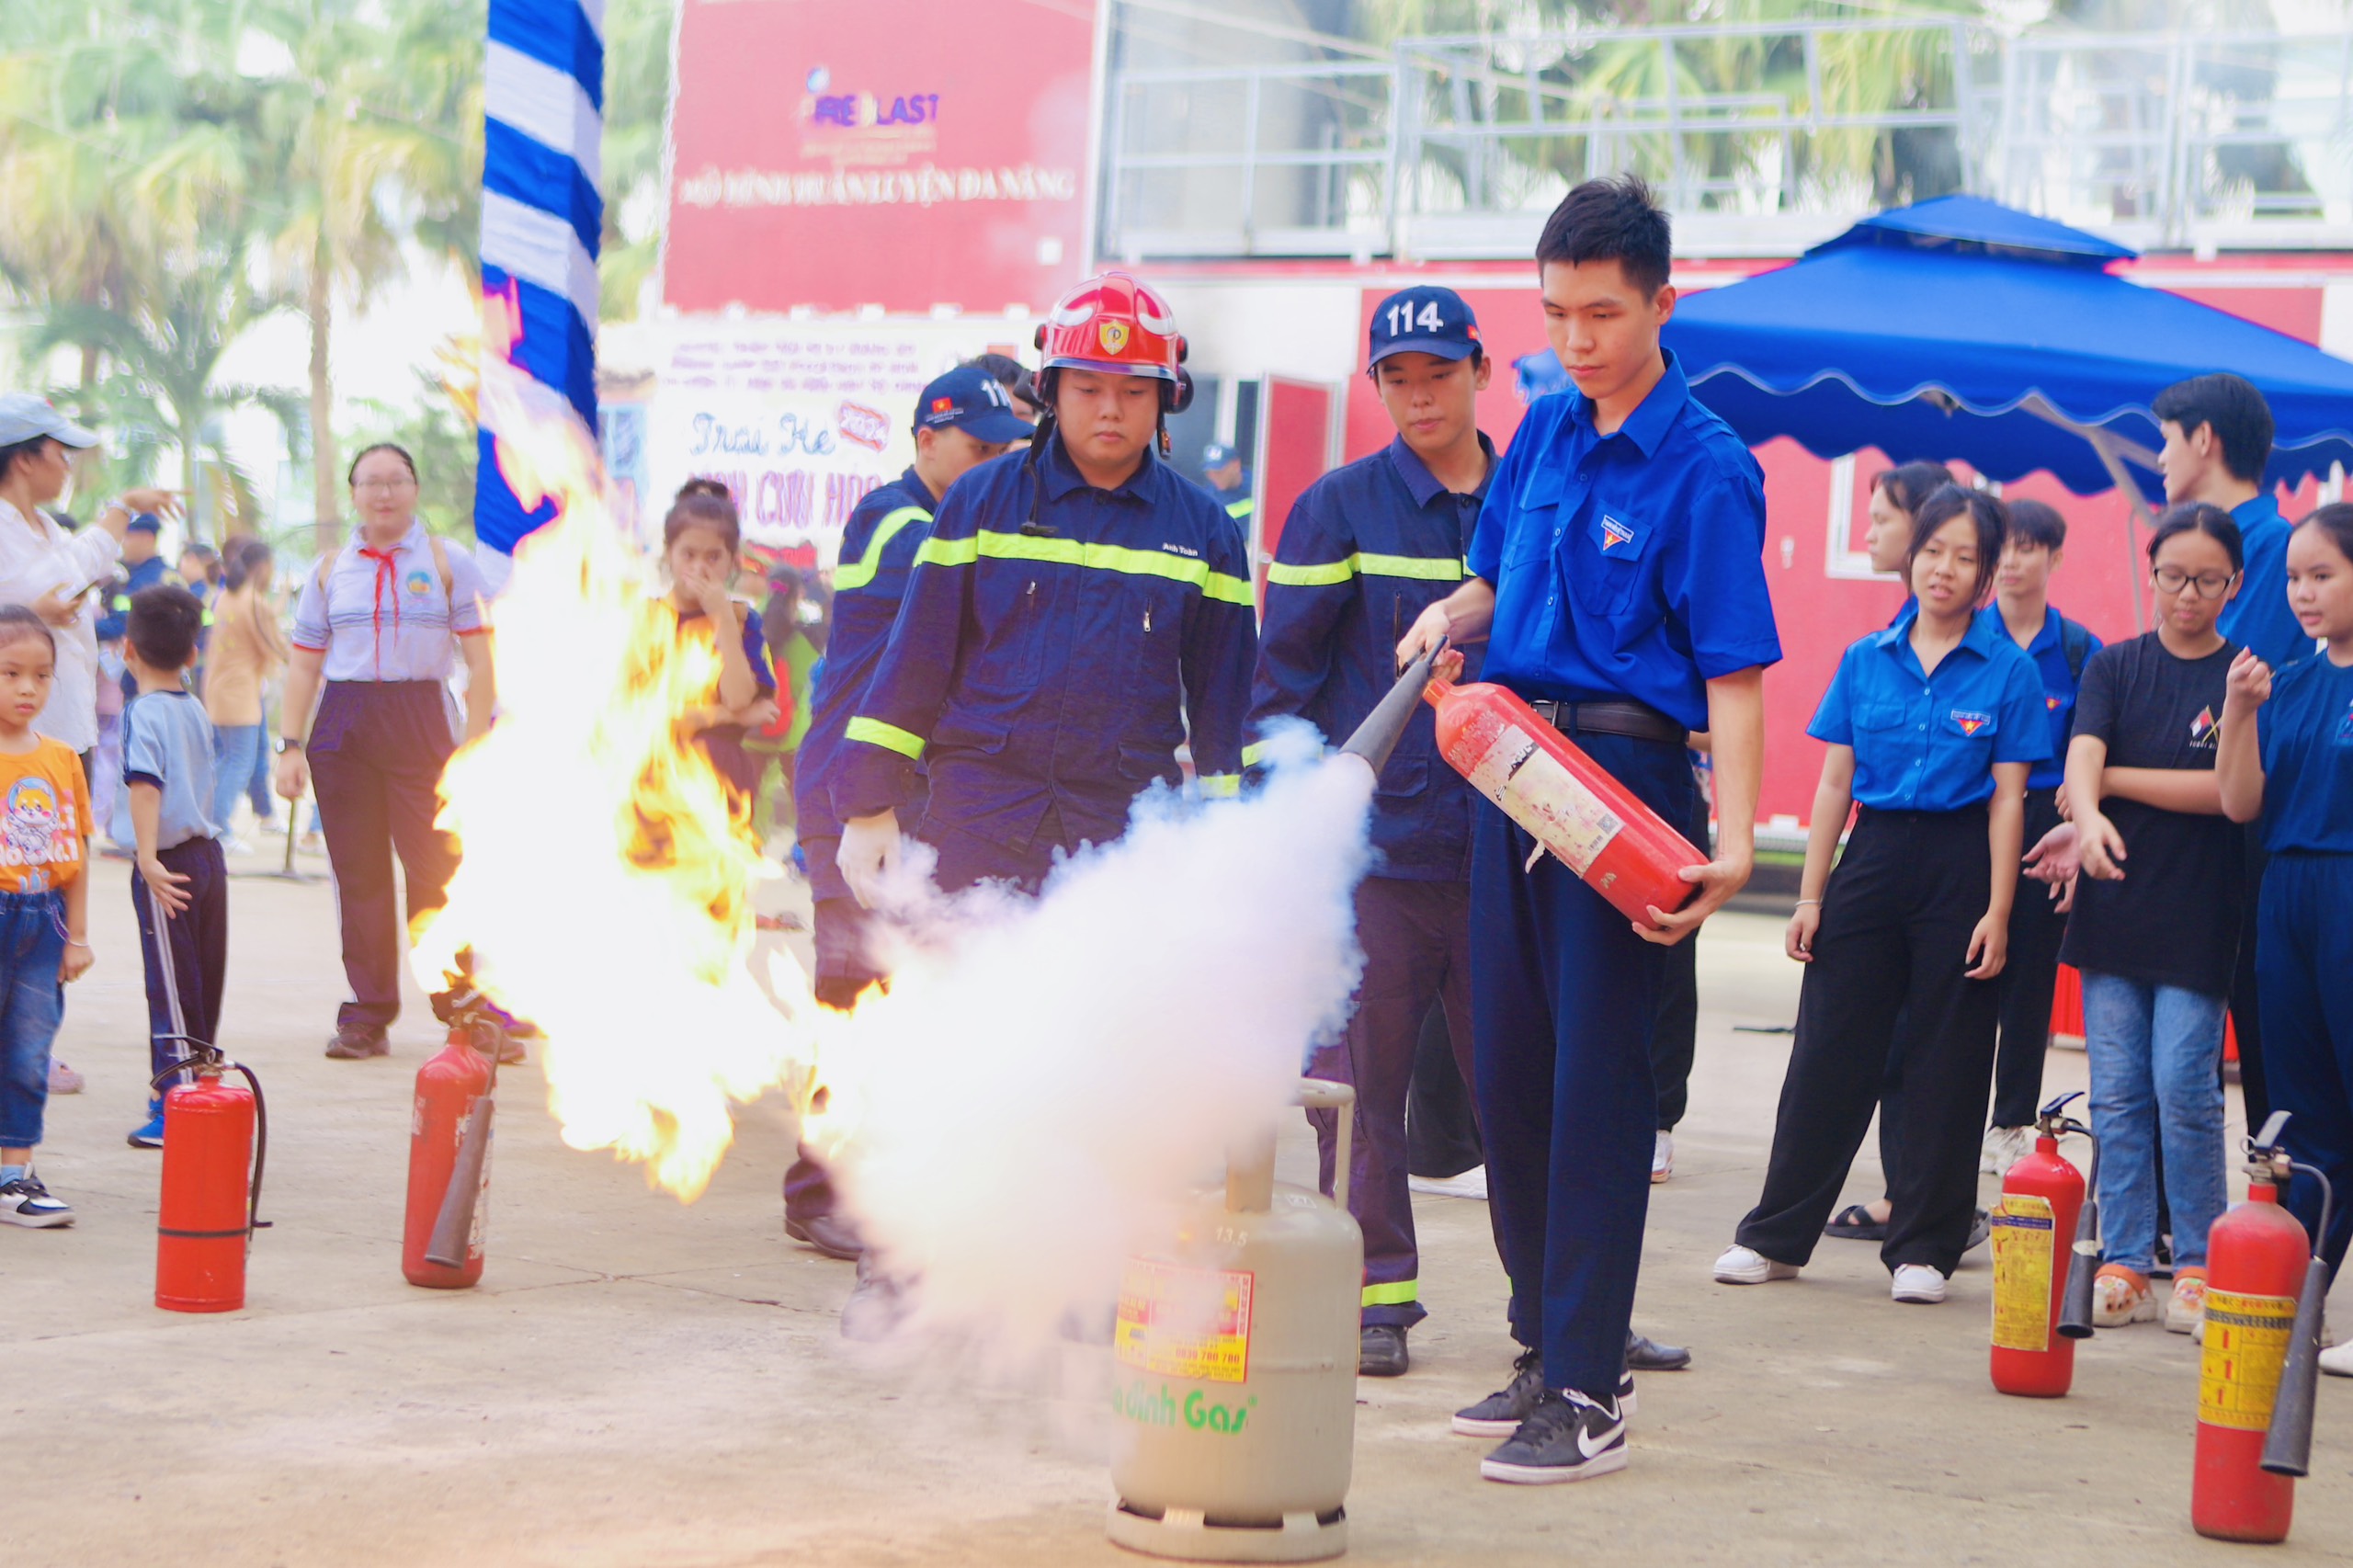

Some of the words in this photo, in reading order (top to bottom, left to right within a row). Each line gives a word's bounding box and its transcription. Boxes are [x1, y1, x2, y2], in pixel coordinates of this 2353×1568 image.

[1387, 300, 1444, 337] 114
[981, 378, 1013, 408] 11
[1162, 541, 1178, 552] Anh
[1184, 1389, 1248, 1436] Gas
